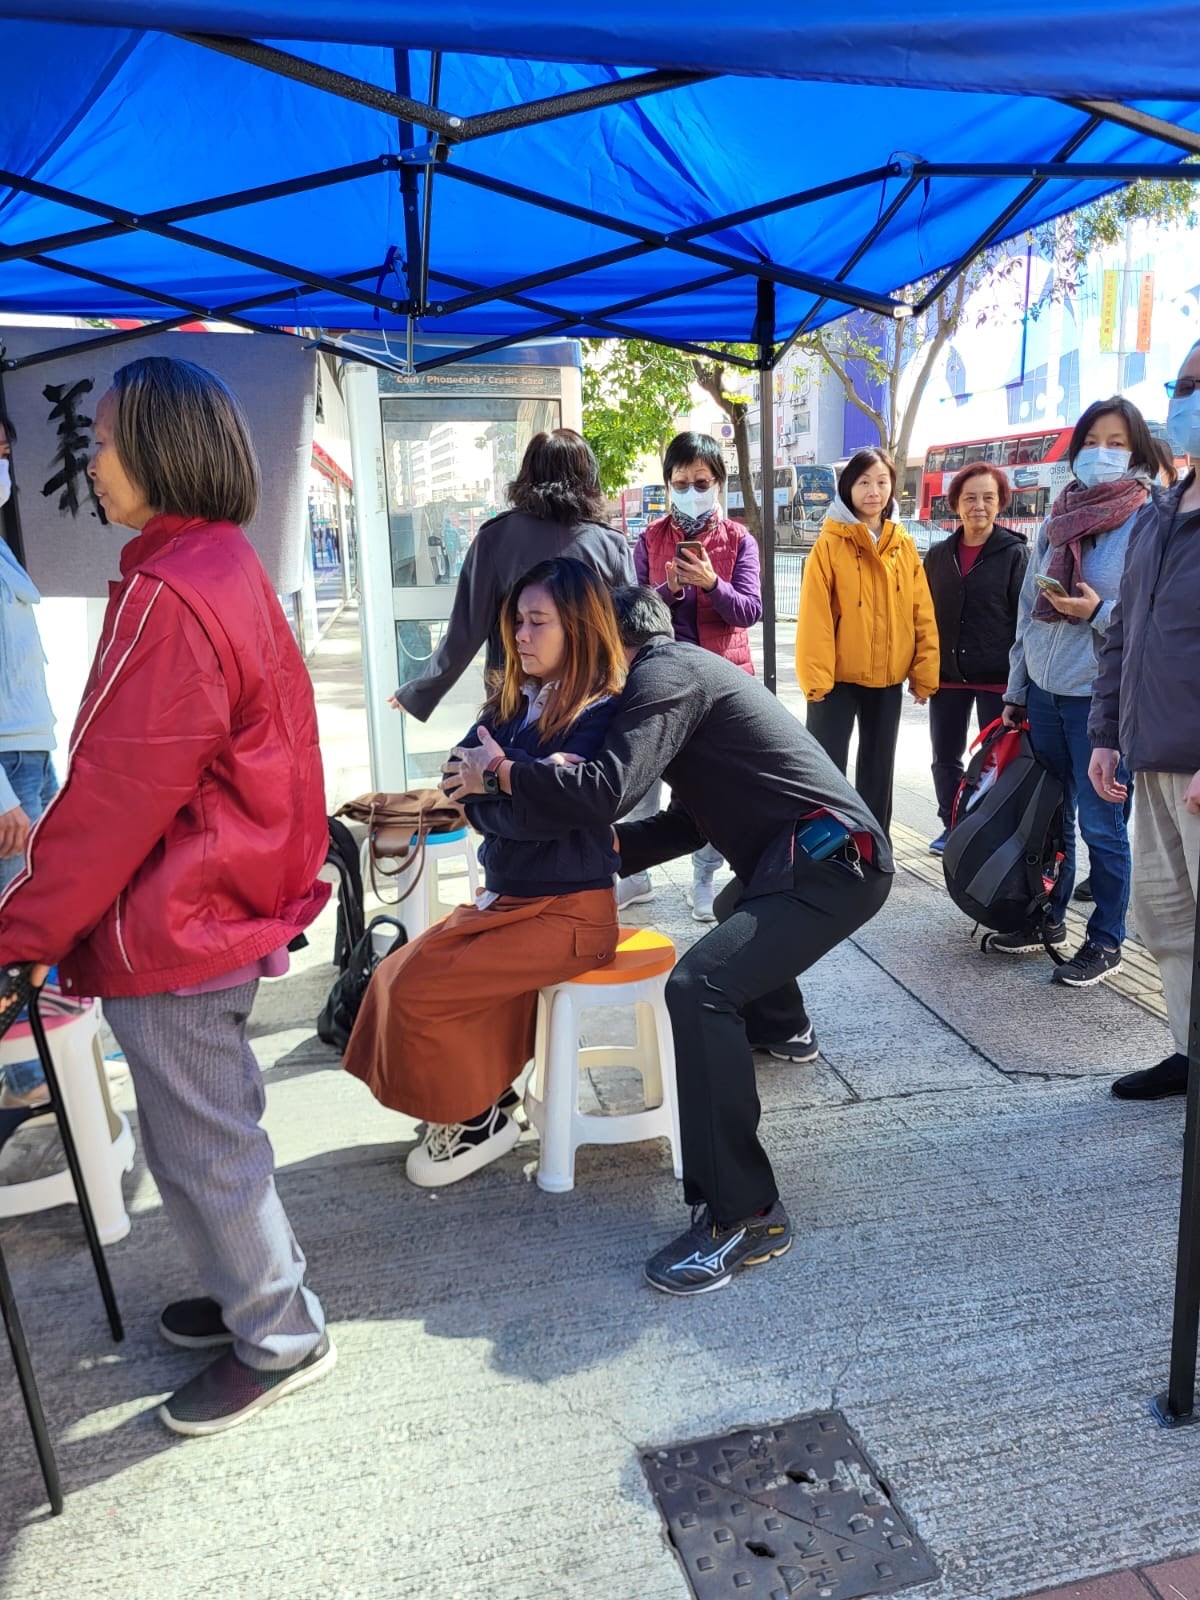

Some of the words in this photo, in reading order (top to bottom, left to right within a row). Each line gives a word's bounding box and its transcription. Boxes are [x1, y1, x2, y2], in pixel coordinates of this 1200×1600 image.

[396, 375, 419, 384] Coin
[426, 375, 480, 384] Phonecard
[488, 376, 518, 384] Credit
[521, 376, 544, 385] Card
